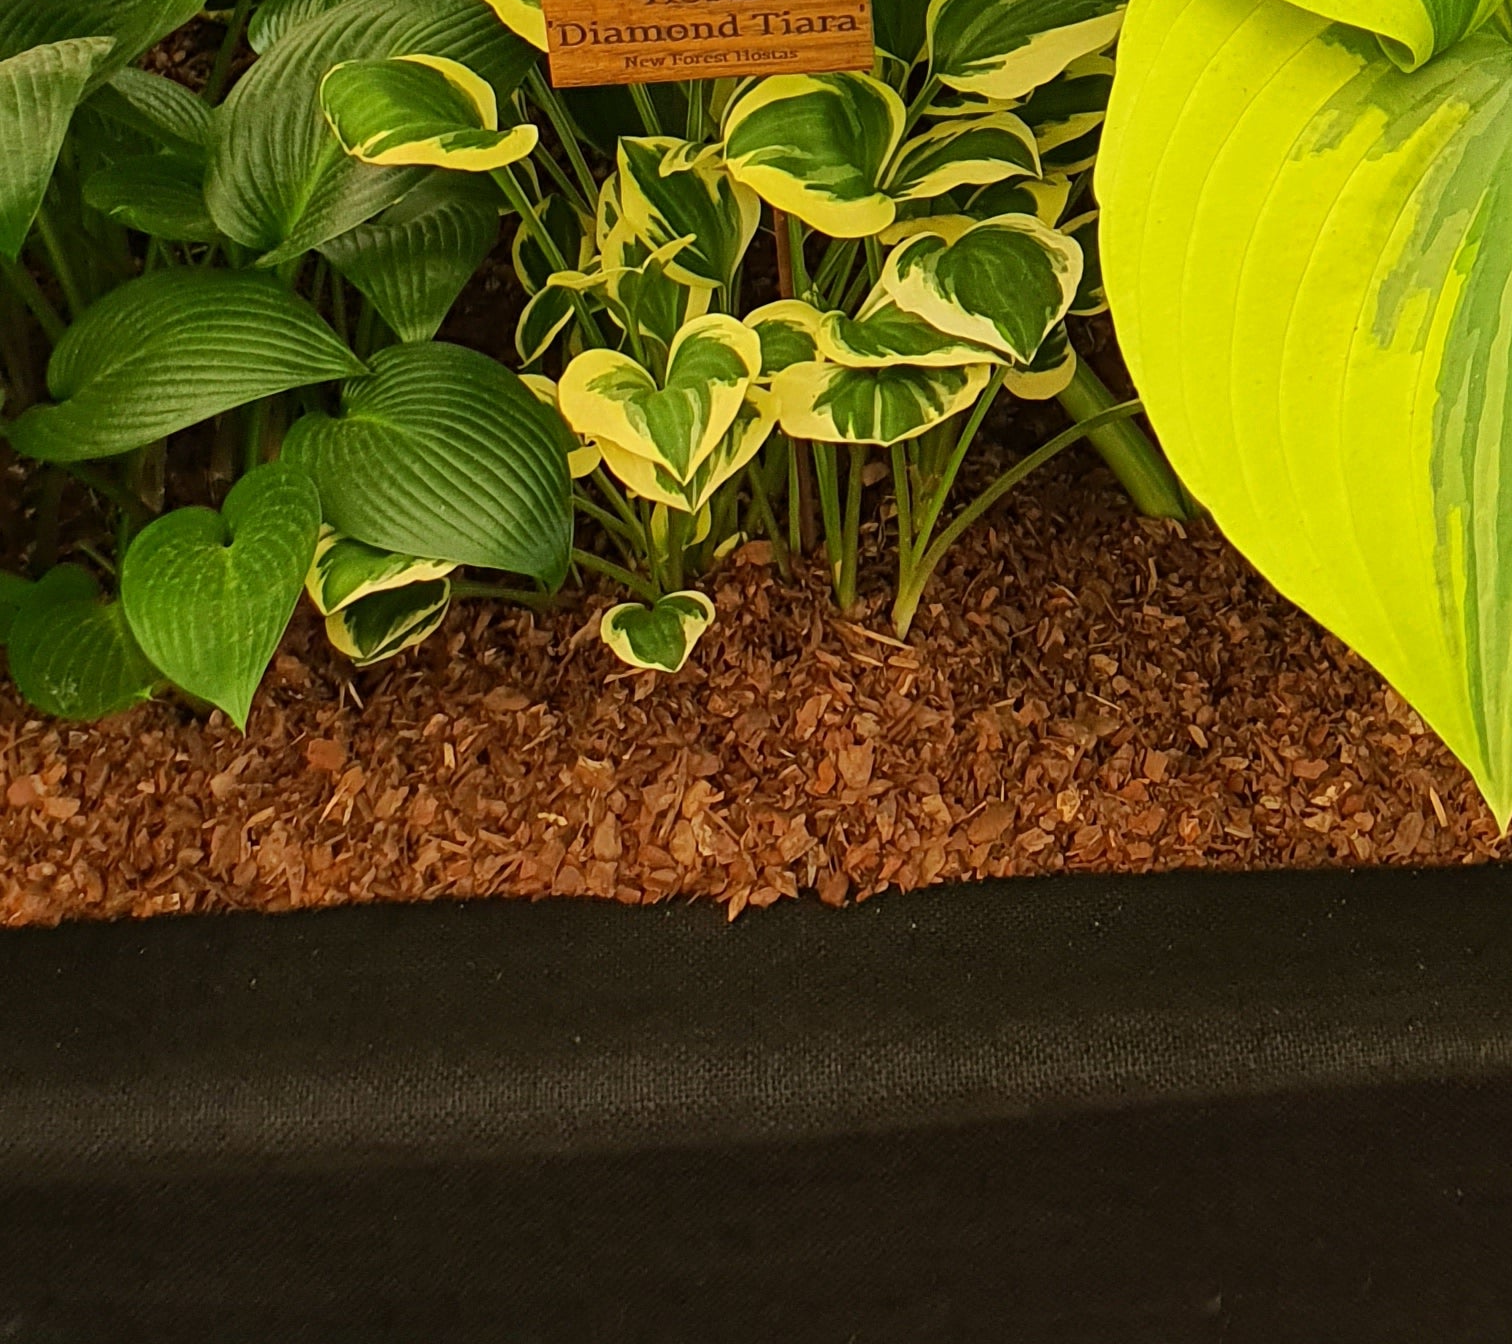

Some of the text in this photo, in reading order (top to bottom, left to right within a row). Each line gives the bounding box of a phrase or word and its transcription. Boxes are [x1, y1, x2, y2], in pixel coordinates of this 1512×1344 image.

[547, 4, 866, 48] 'Diamond Tiara'
[624, 48, 799, 70] New Forest Hostas
